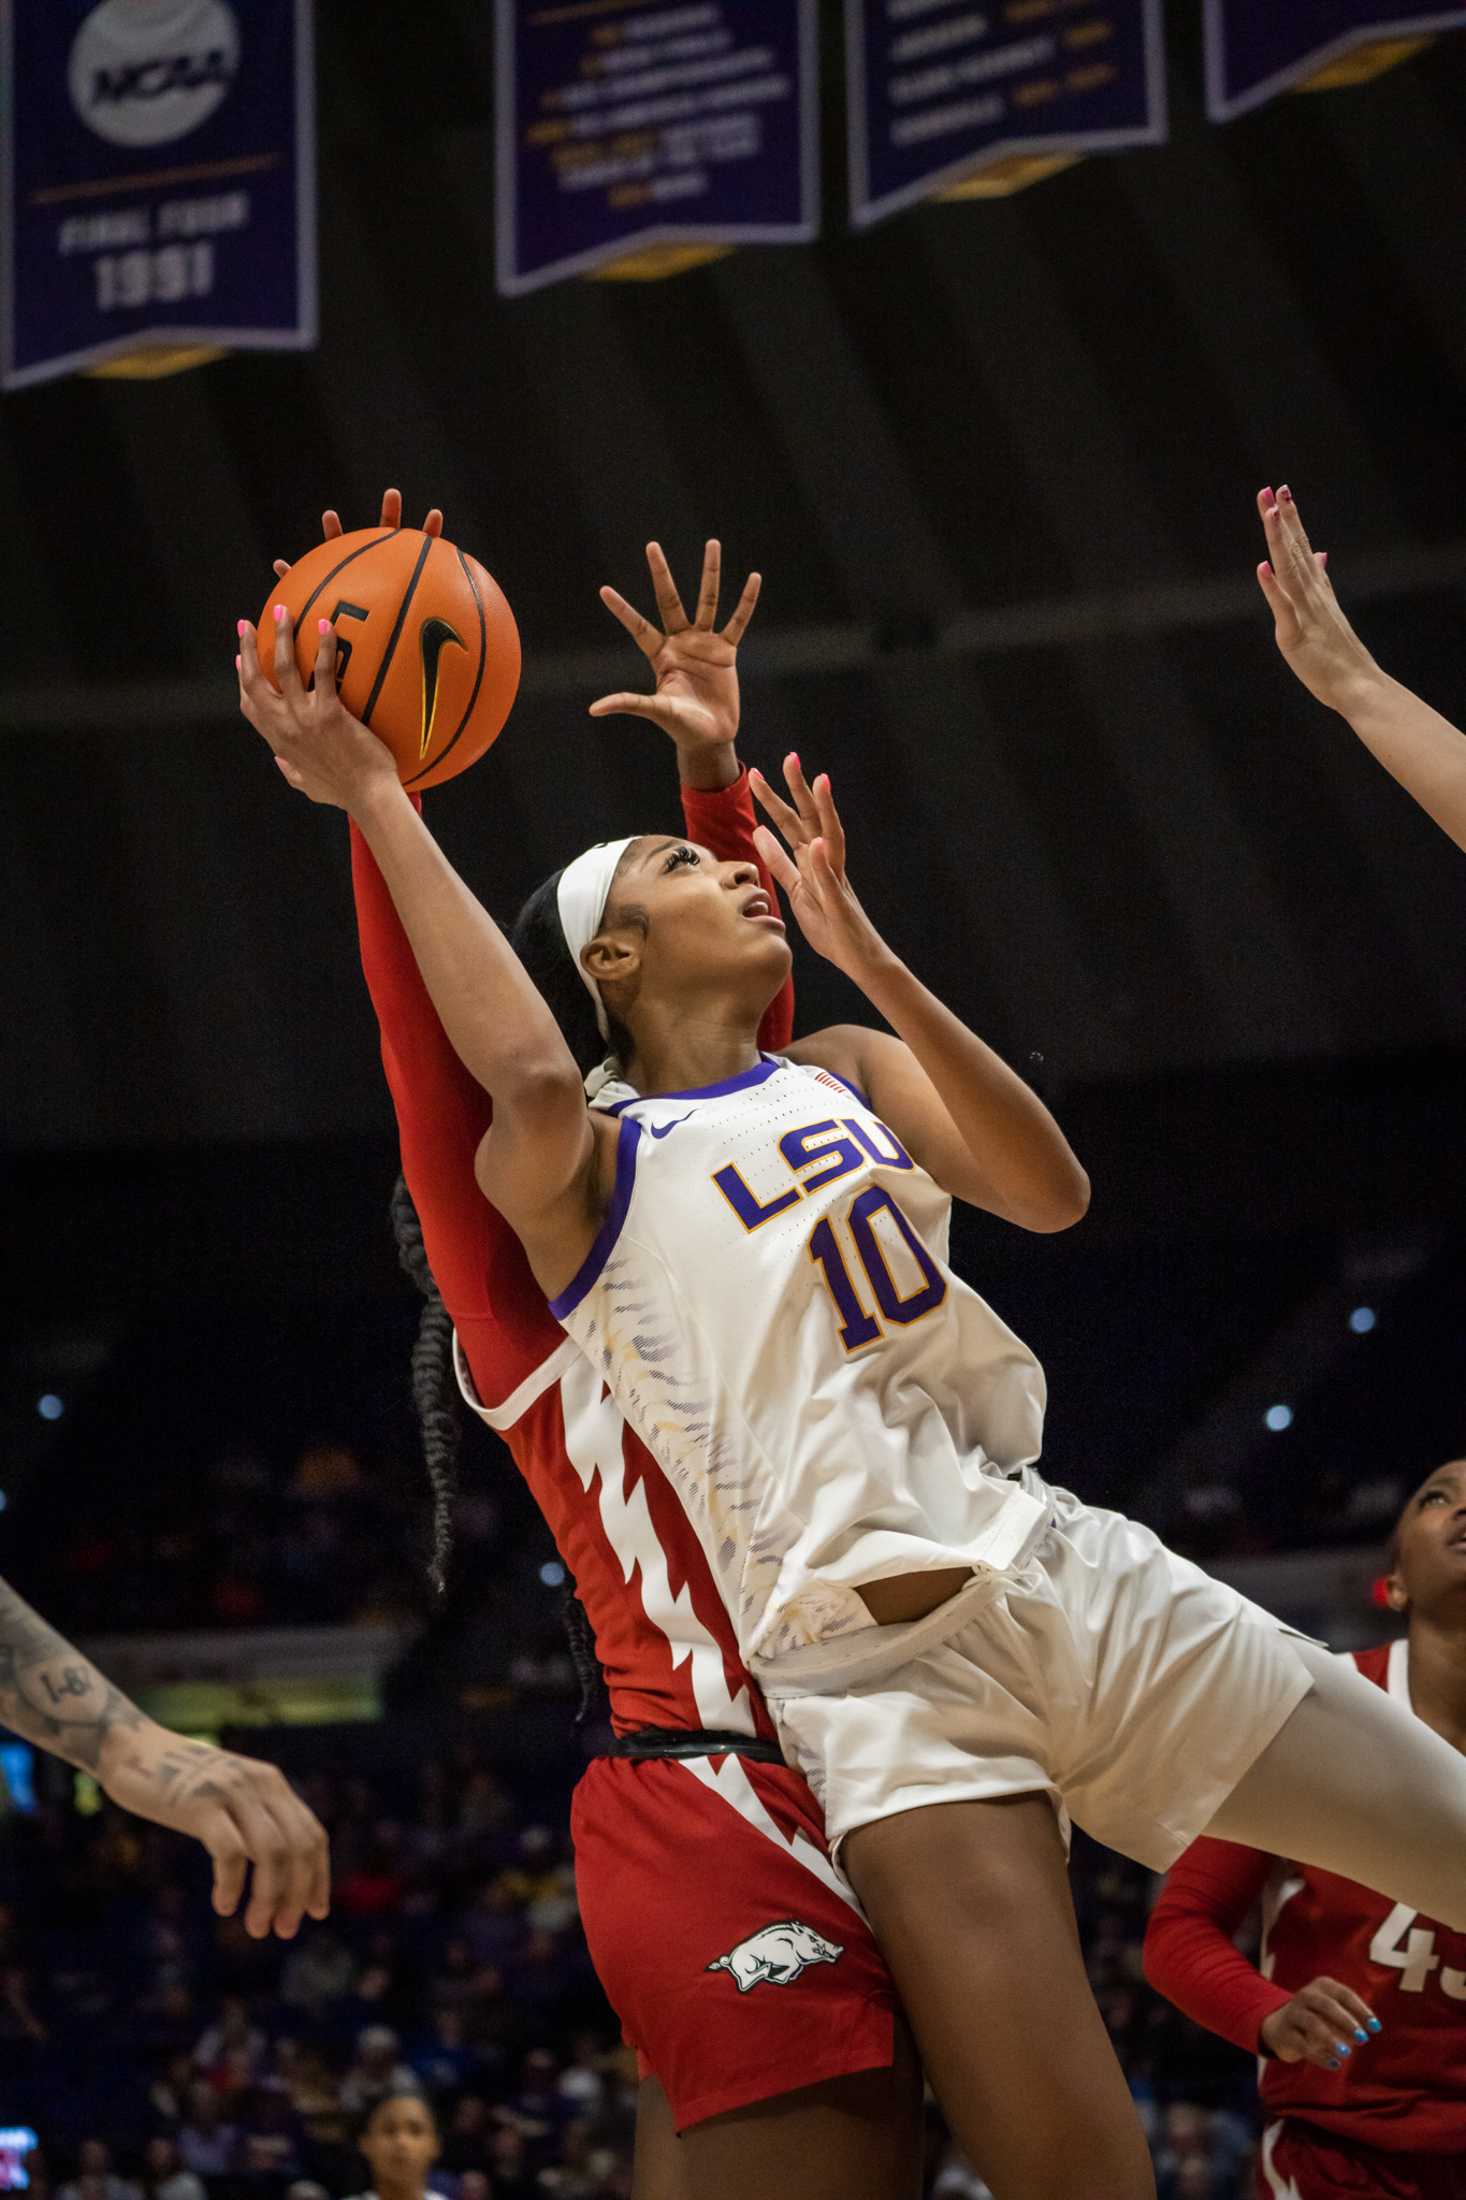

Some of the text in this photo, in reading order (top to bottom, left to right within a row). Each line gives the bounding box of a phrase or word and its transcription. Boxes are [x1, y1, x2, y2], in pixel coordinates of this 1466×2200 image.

[91, 50, 232, 103] NCAA
[96, 240, 214, 312] 1991
[711, 1118, 917, 1233] LSU
[808, 1184, 949, 1354] 10
